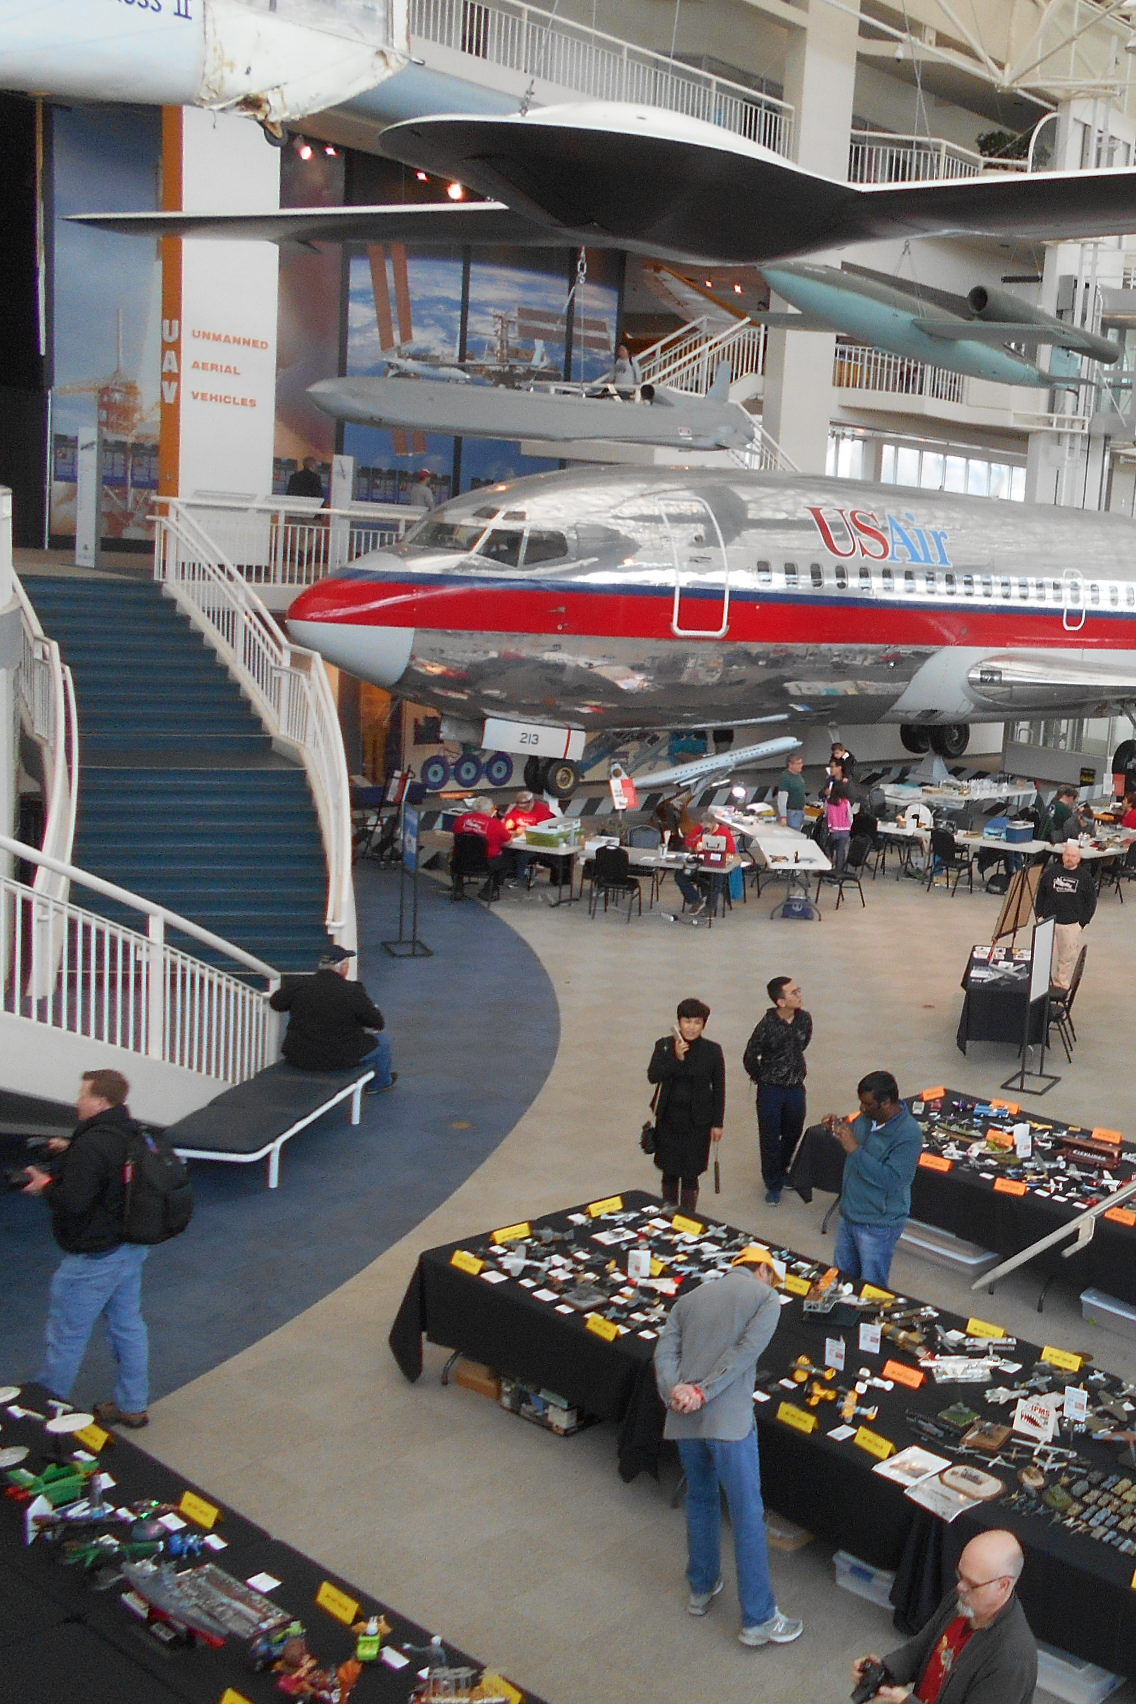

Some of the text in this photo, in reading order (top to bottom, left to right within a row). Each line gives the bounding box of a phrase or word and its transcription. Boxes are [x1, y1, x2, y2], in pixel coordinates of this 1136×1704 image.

[191, 329, 269, 350] UNMANNED
[162, 319, 179, 404] UAV
[191, 360, 241, 375] AERIAL
[191, 391, 257, 408] VEHICLES
[804, 506, 952, 567] USAir
[519, 732, 540, 745] 213
